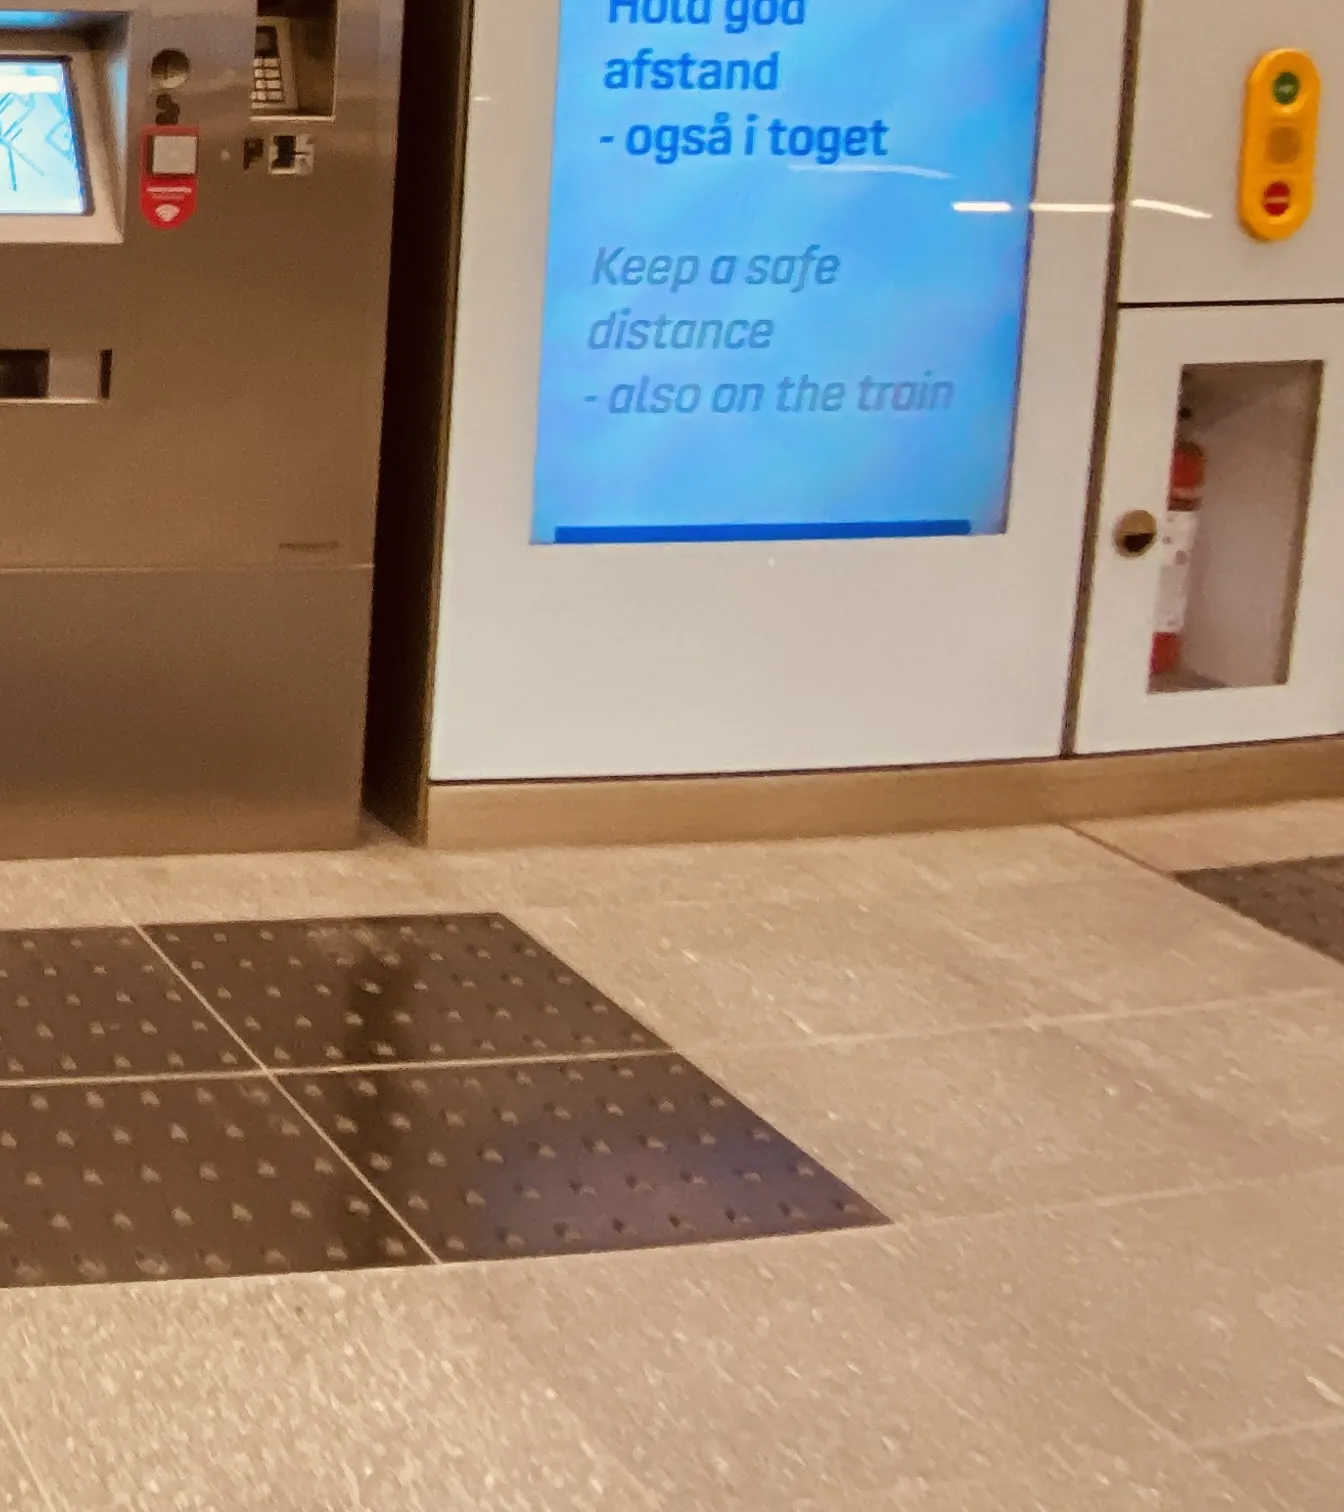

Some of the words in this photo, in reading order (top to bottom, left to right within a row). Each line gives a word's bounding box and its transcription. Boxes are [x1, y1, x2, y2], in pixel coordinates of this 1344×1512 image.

[603, 47, 780, 91] afstand
[625, 111, 732, 166] også
[744, 113, 760, 156] i
[767, 118, 890, 166] toget
[590, 246, 701, 294] Keep
[710, 253, 737, 286] a
[745, 243, 842, 294] safe
[586, 307, 775, 350] distance
[608, 374, 702, 414] also
[711, 381, 766, 414] on
[775, 373, 846, 413] the
[857, 369, 955, 413] train
